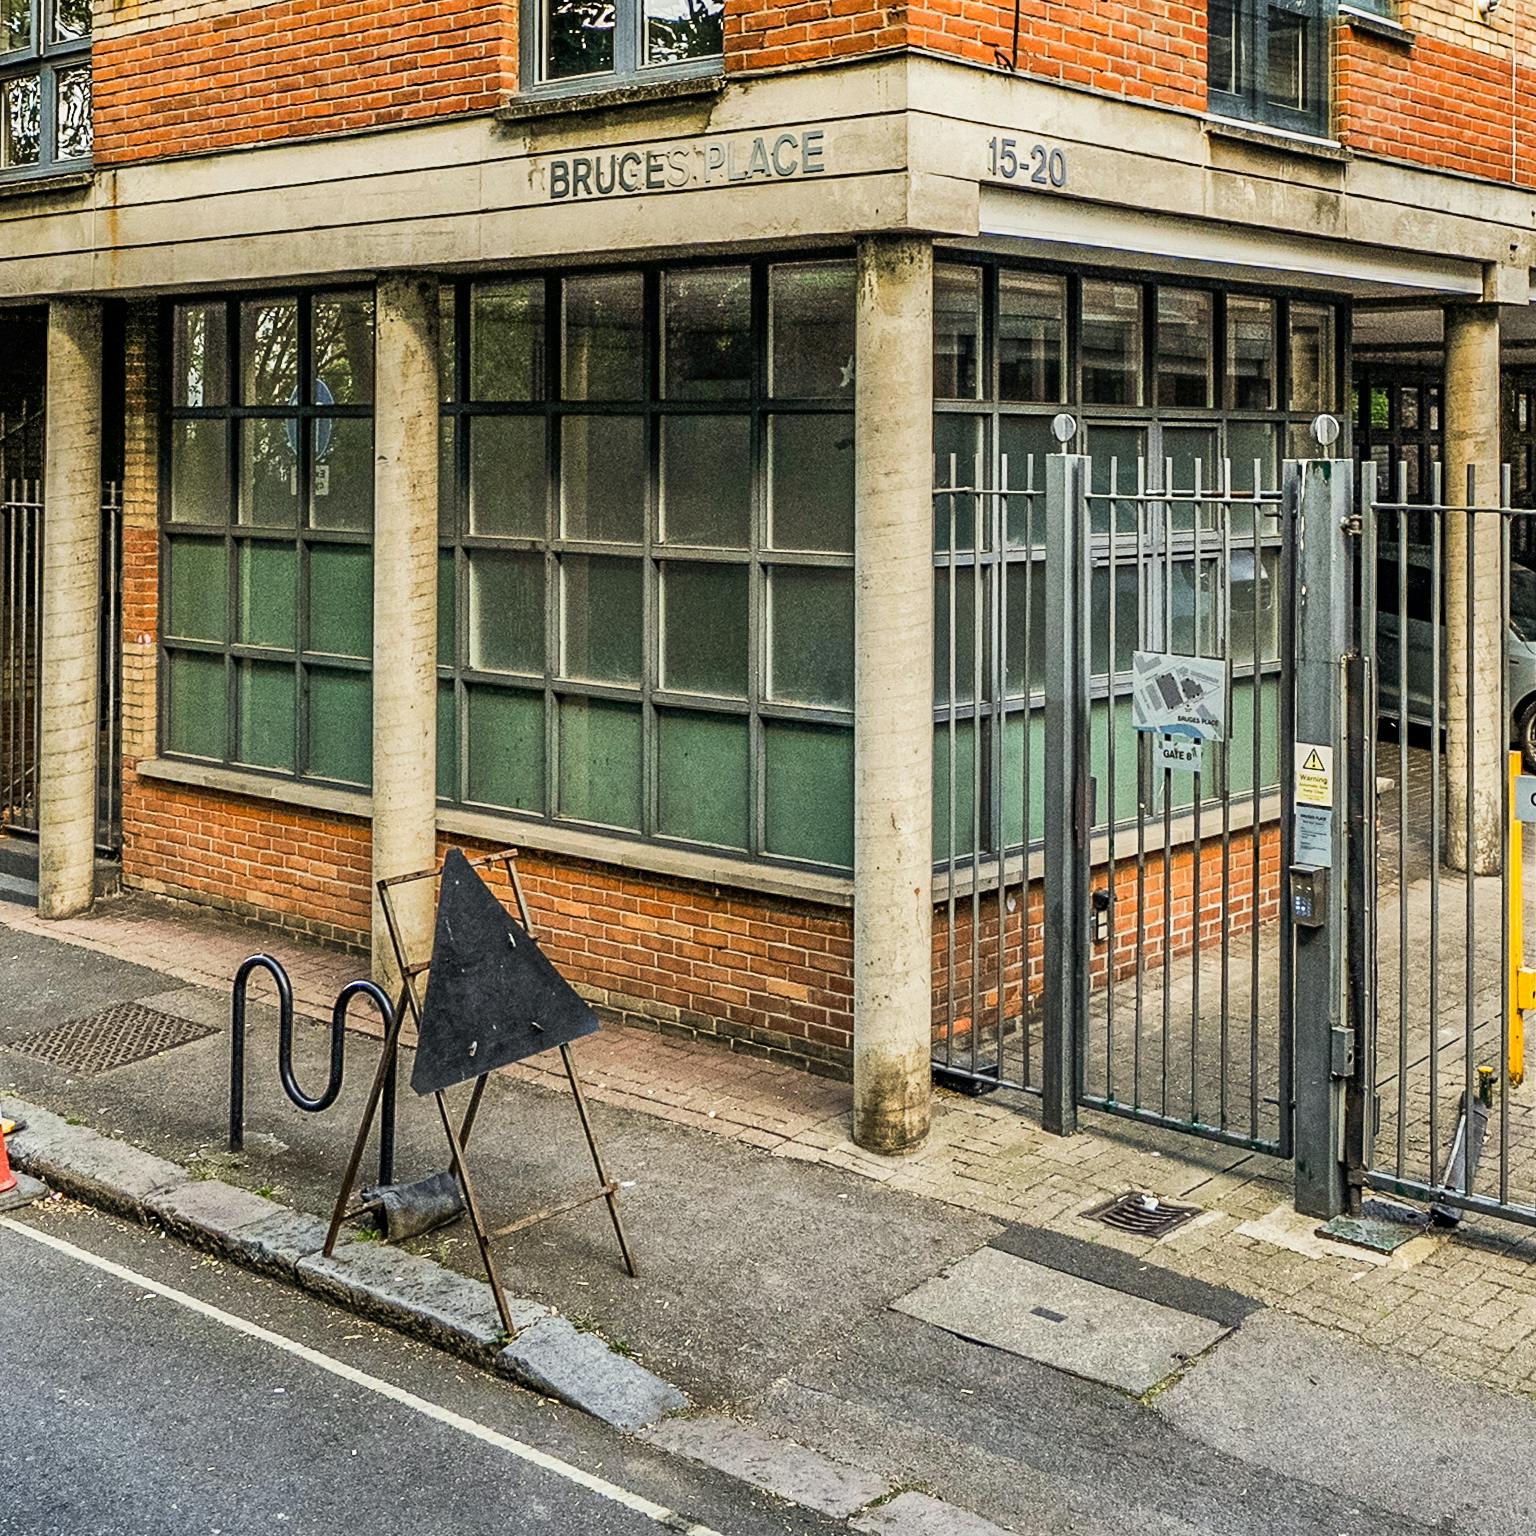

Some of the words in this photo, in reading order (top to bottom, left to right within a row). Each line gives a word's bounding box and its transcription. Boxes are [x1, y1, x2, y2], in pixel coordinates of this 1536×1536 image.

[550, 145, 690, 199] BRUGES
[704, 130, 825, 183] PLACE
[989, 137, 1066, 187] 15-20
[1178, 715, 1200, 724] BRUGES
[1163, 748, 1184, 760] GATE
[1186, 752, 1192, 761] 8
[1299, 774, 1328, 785] Warning
